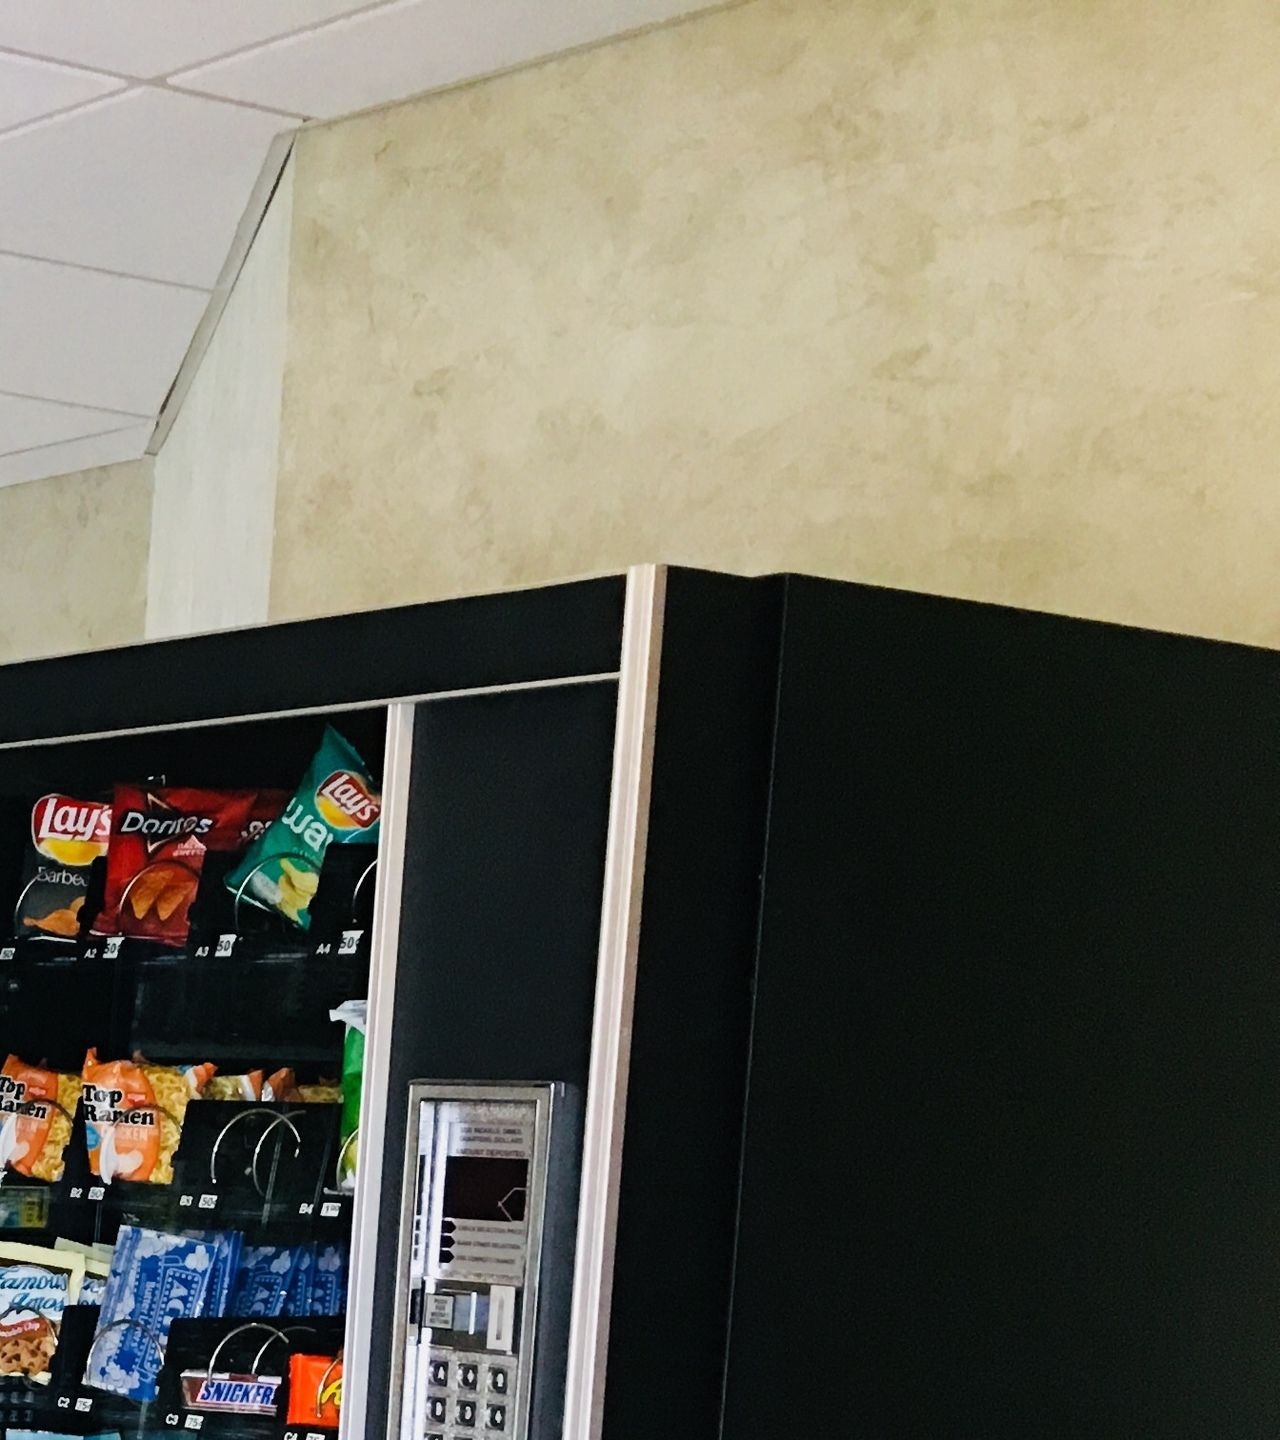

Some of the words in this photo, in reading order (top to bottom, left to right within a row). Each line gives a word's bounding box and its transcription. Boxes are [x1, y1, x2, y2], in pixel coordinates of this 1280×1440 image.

[38, 798, 112, 841] Lay's
[121, 811, 213, 834] Doritos
[83, 1084, 122, 1108] Top
[84, 1103, 154, 1125] Ramen
[202, 1382, 273, 1405] SNICKER
